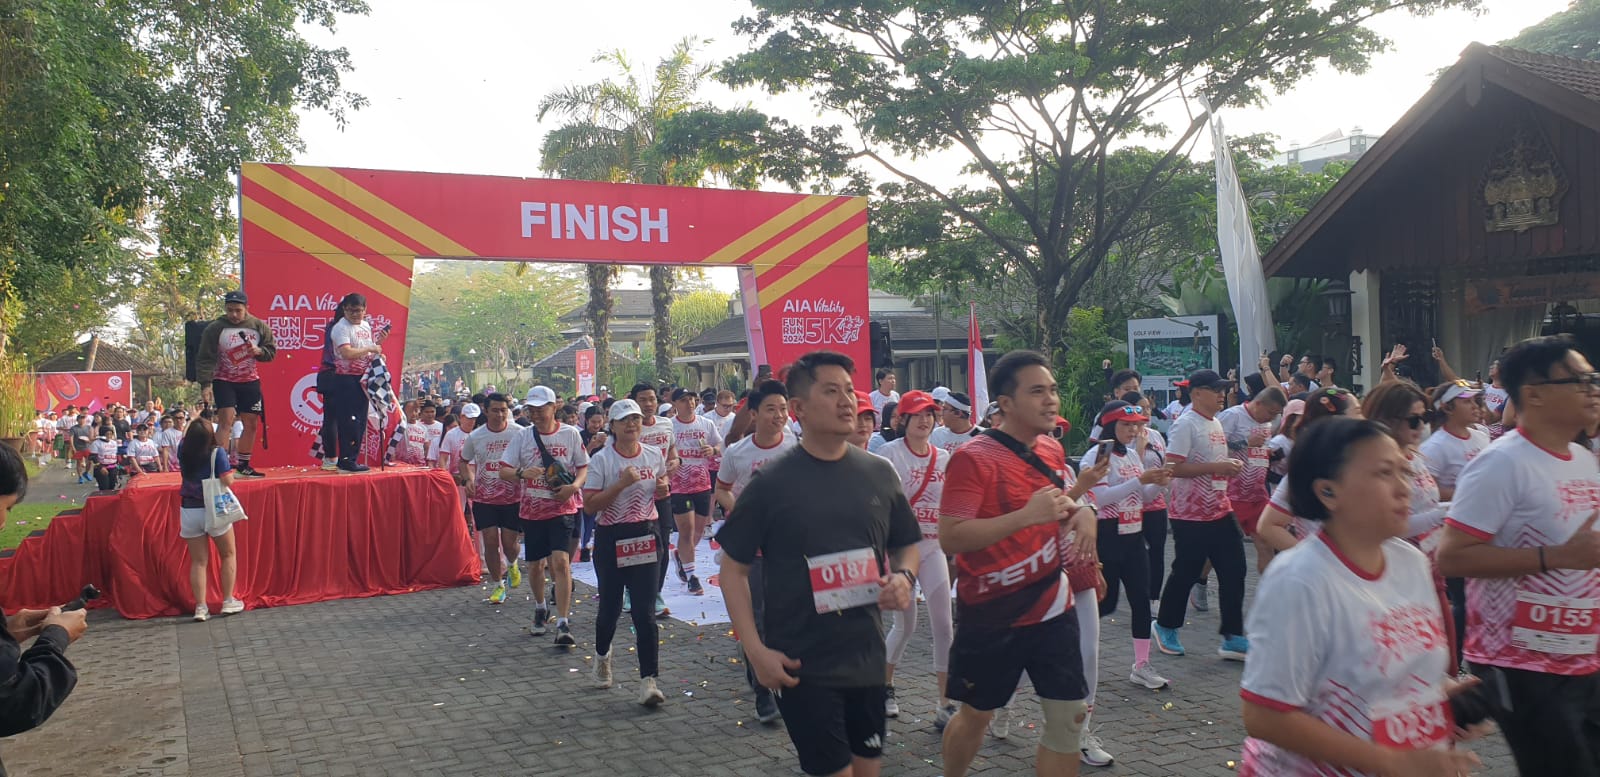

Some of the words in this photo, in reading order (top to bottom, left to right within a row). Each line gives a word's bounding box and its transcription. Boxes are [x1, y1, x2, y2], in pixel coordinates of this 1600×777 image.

[521, 201, 669, 243] FINISH
[270, 294, 313, 311] AIA
[783, 299, 812, 313] AIA
[814, 297, 845, 317] Vitality
[270, 316, 300, 328] FUN
[783, 318, 804, 327] FUN
[271, 328, 300, 339] RUN
[302, 317, 327, 349] 5
[783, 327, 804, 336] RUN
[805, 317, 847, 344] 5K
[275, 339, 300, 349] 024
[783, 335, 804, 343] 2024
[291, 420, 309, 433] LILY
[656, 435, 668, 444] 5K
[693, 431, 705, 440] 5K
[552, 447, 567, 457] 5K
[639, 469, 655, 480] 5K
[622, 541, 651, 553] 0123
[979, 536, 1058, 594] PETE
[821, 560, 868, 584] 0187
[1530, 605, 1592, 627] 0155
